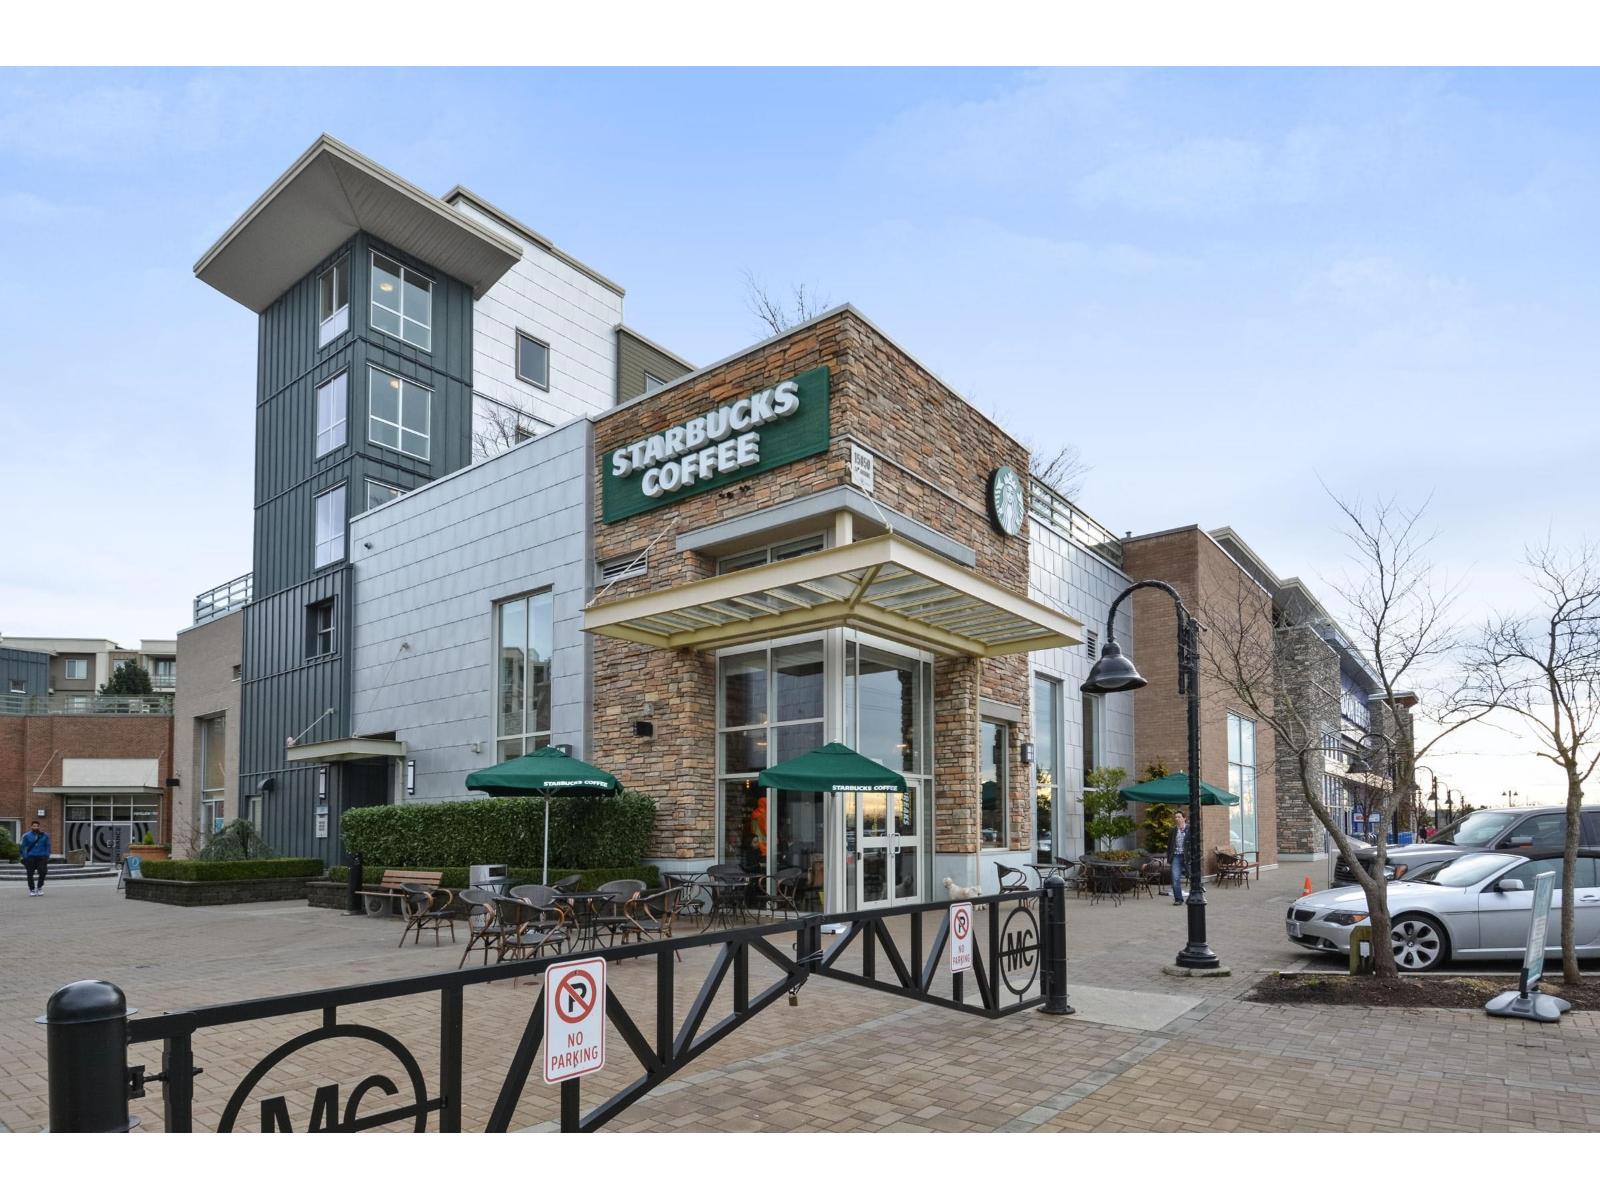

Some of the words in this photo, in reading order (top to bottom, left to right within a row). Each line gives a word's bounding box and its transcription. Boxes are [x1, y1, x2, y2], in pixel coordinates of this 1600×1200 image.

[612, 381, 800, 478] STARBUCKS
[641, 431, 760, 498] COFFEE
[584, 780, 608, 788] COFFEE
[952, 954, 970, 964] PARKING
[958, 944, 964, 953] NO
[1007, 929, 1034, 972] MC
[567, 1031, 583, 1048] NO
[551, 1045, 598, 1071] PARKING
